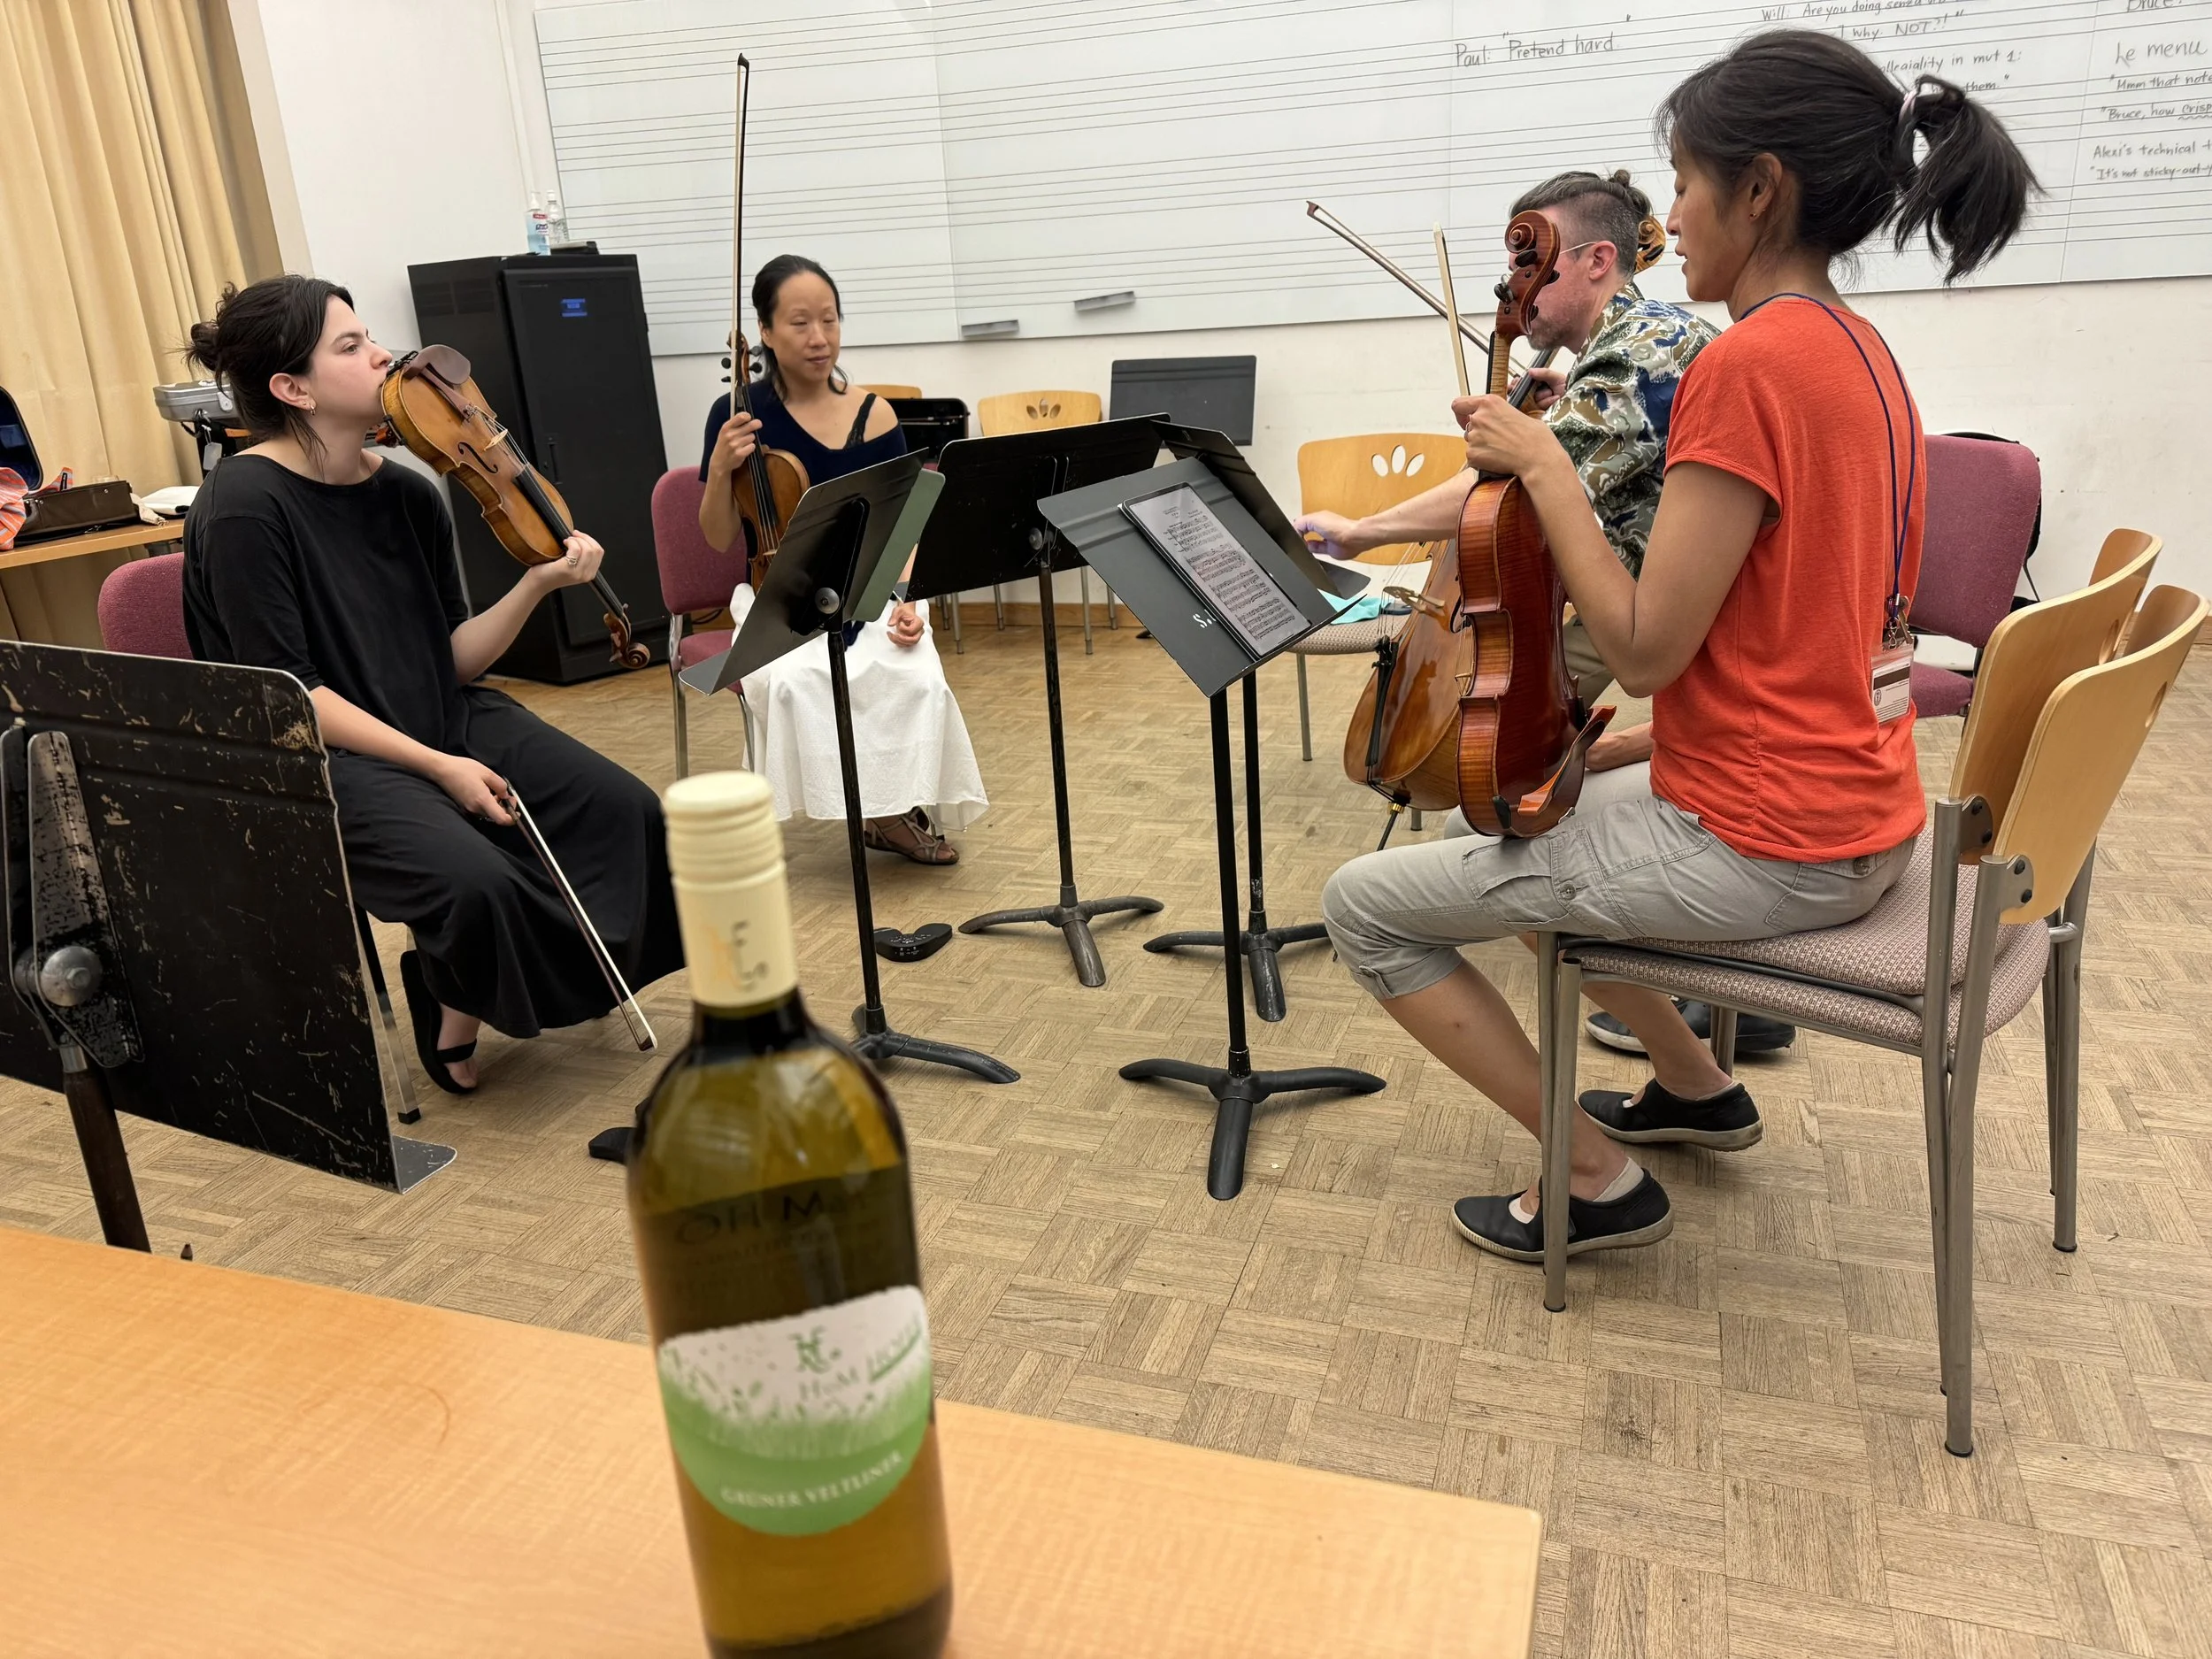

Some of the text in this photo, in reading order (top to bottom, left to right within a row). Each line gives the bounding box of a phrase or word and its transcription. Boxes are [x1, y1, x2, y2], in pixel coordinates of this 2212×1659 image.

[1803, 4, 1821, 17] Are
[1826, 5, 1846, 21] you
[1852, 0, 1880, 15] doing
[1455, 43, 1491, 67] Paul:
[1952, 53, 1963, 65] in
[2116, 41, 2208, 67] Le menu
[2150, 74, 2180, 88] that
[2150, 103, 2174, 116] how
[2139, 142, 2195, 156] technical
[2122, 168, 2138, 178] not
